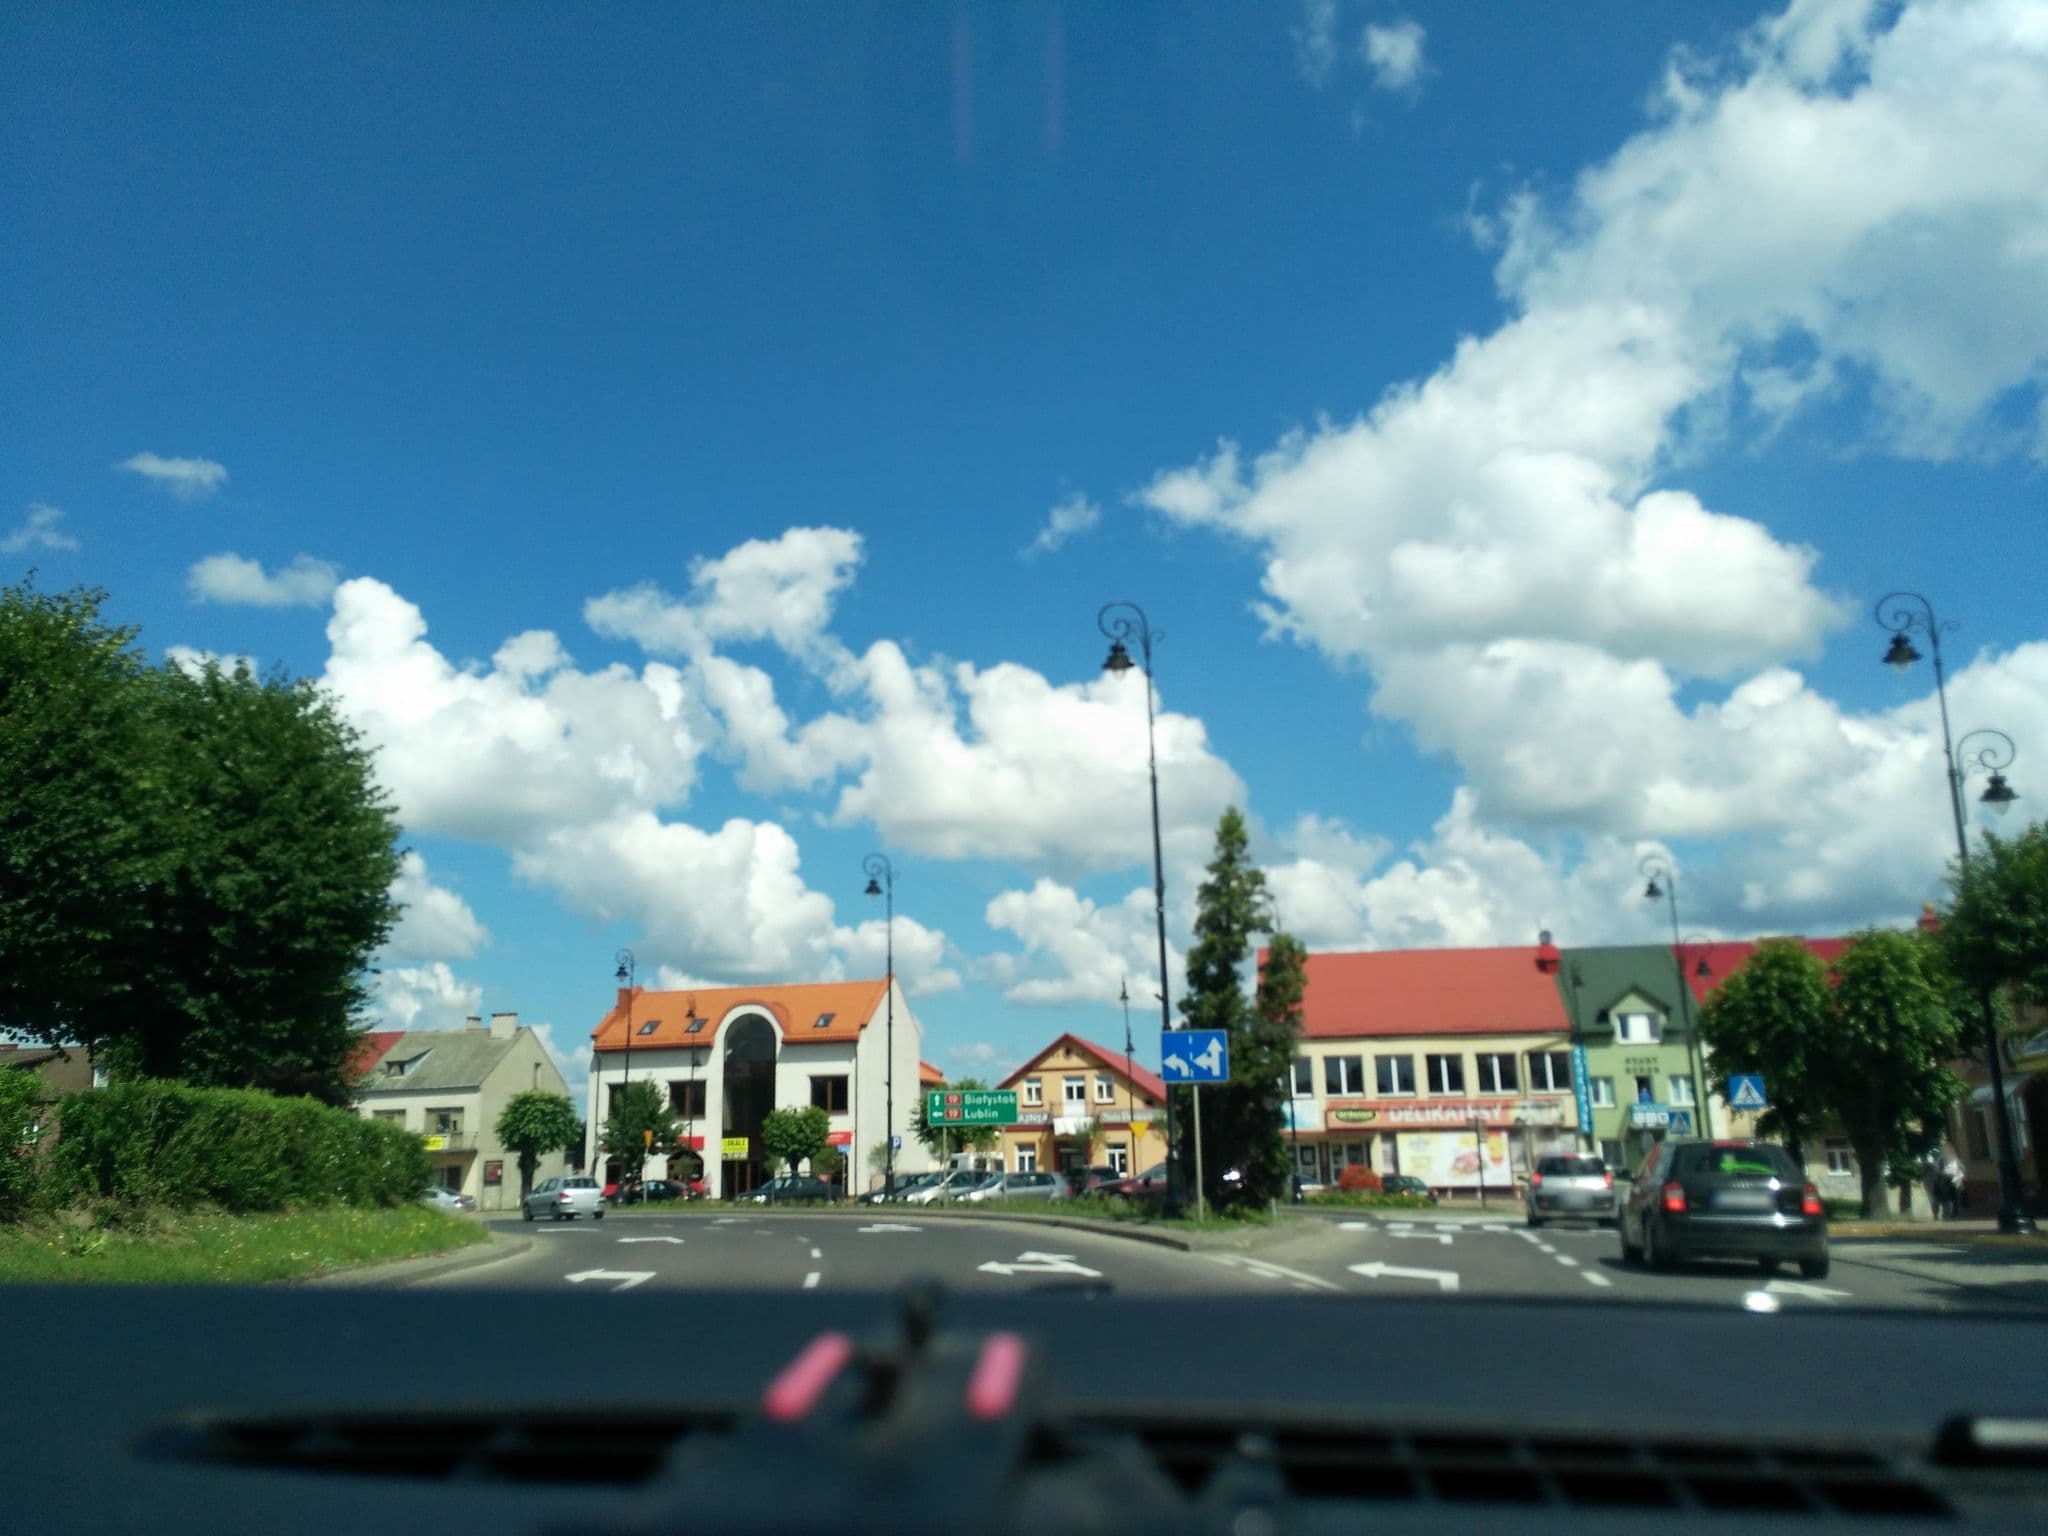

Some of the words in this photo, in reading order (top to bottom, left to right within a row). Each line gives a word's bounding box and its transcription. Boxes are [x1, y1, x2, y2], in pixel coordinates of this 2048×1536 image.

[948, 1095, 959, 1104] 19
[964, 1094, 1016, 1106] Białystok
[948, 1109, 959, 1118] 19
[964, 1108, 998, 1119] Lublin
